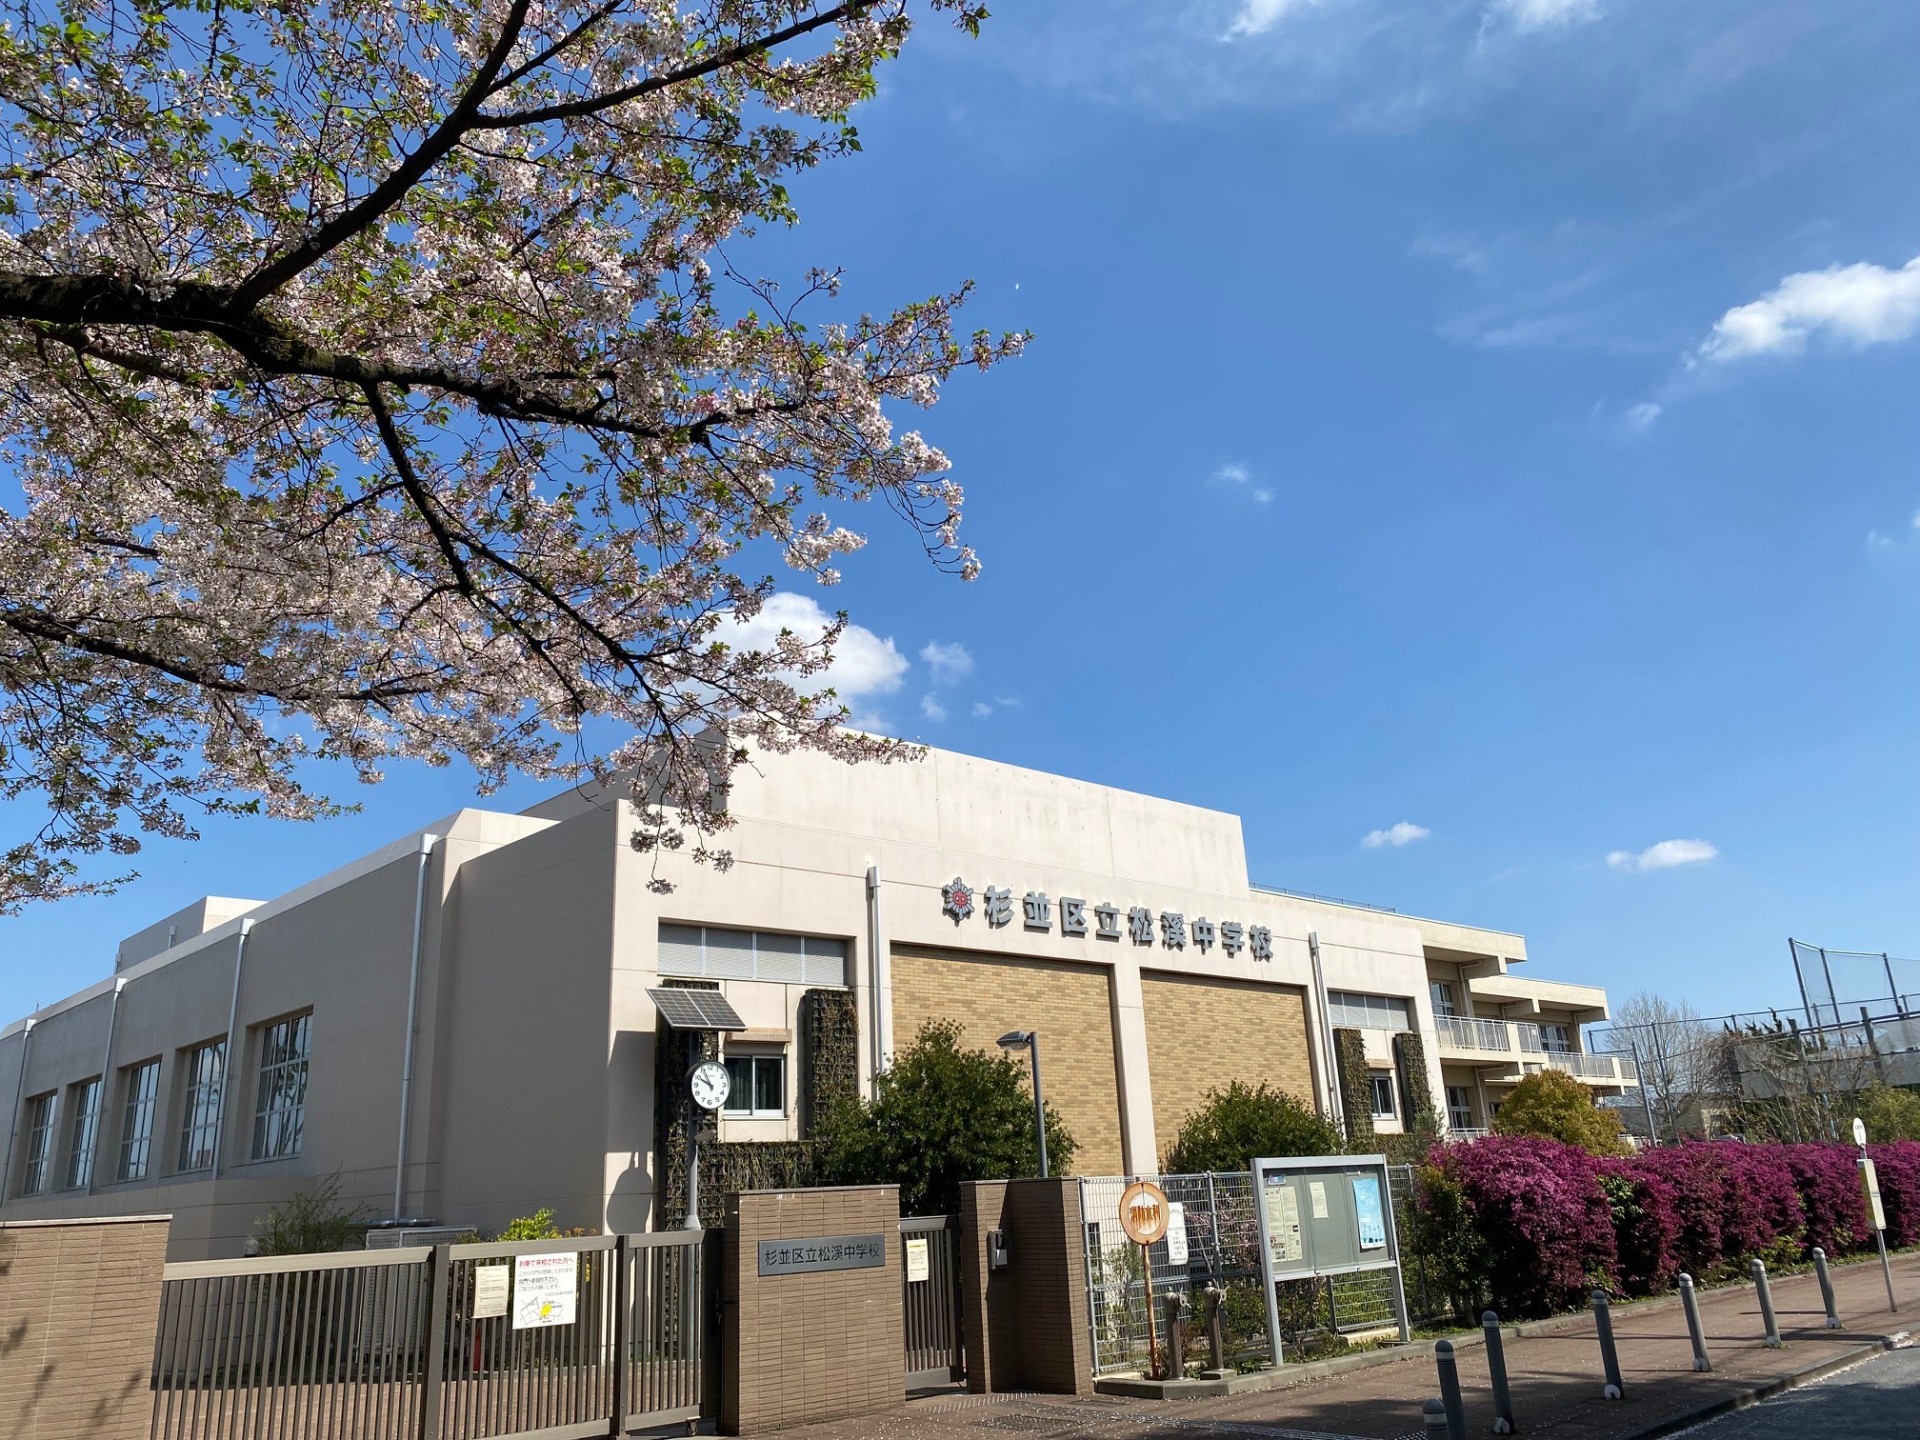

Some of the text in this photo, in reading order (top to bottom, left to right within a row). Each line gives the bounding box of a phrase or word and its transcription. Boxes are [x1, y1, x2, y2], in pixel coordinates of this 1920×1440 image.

[983, 884, 1274, 961] 杉並区立松溪中学校
[765, 1243, 880, 1266] 杉並区立松溪中学校
